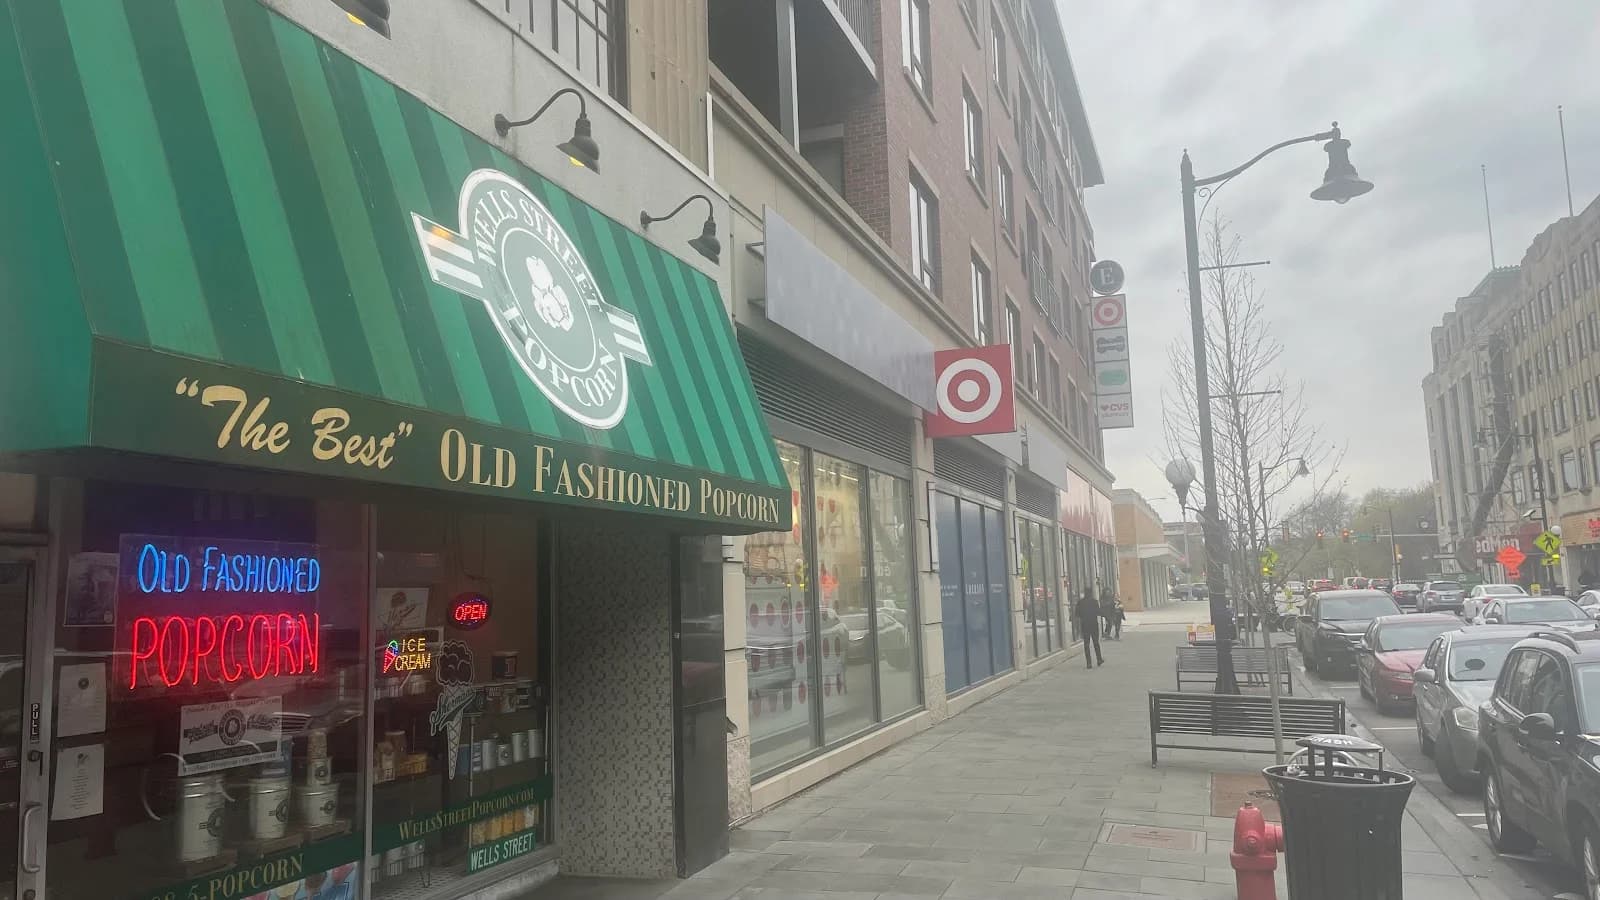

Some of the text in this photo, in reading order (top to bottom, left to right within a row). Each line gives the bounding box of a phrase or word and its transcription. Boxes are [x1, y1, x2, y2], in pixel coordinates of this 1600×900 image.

[473, 189, 604, 313] WELLS STREET
[502, 302, 618, 408] POPCORN
[1110, 402, 1129, 411] CVS
[440, 428, 780, 524] OLD FASHIONED POPCORN
[137, 543, 321, 594] OLD FASHIONED
[455, 603, 488, 621] OPEN
[129, 612, 320, 690] POPCORN
[395, 653, 432, 672] CREAM
[402, 638, 426, 653] ICE
[32, 703, 40, 736] PULL
[470, 832, 534, 872] WELLS STREET
